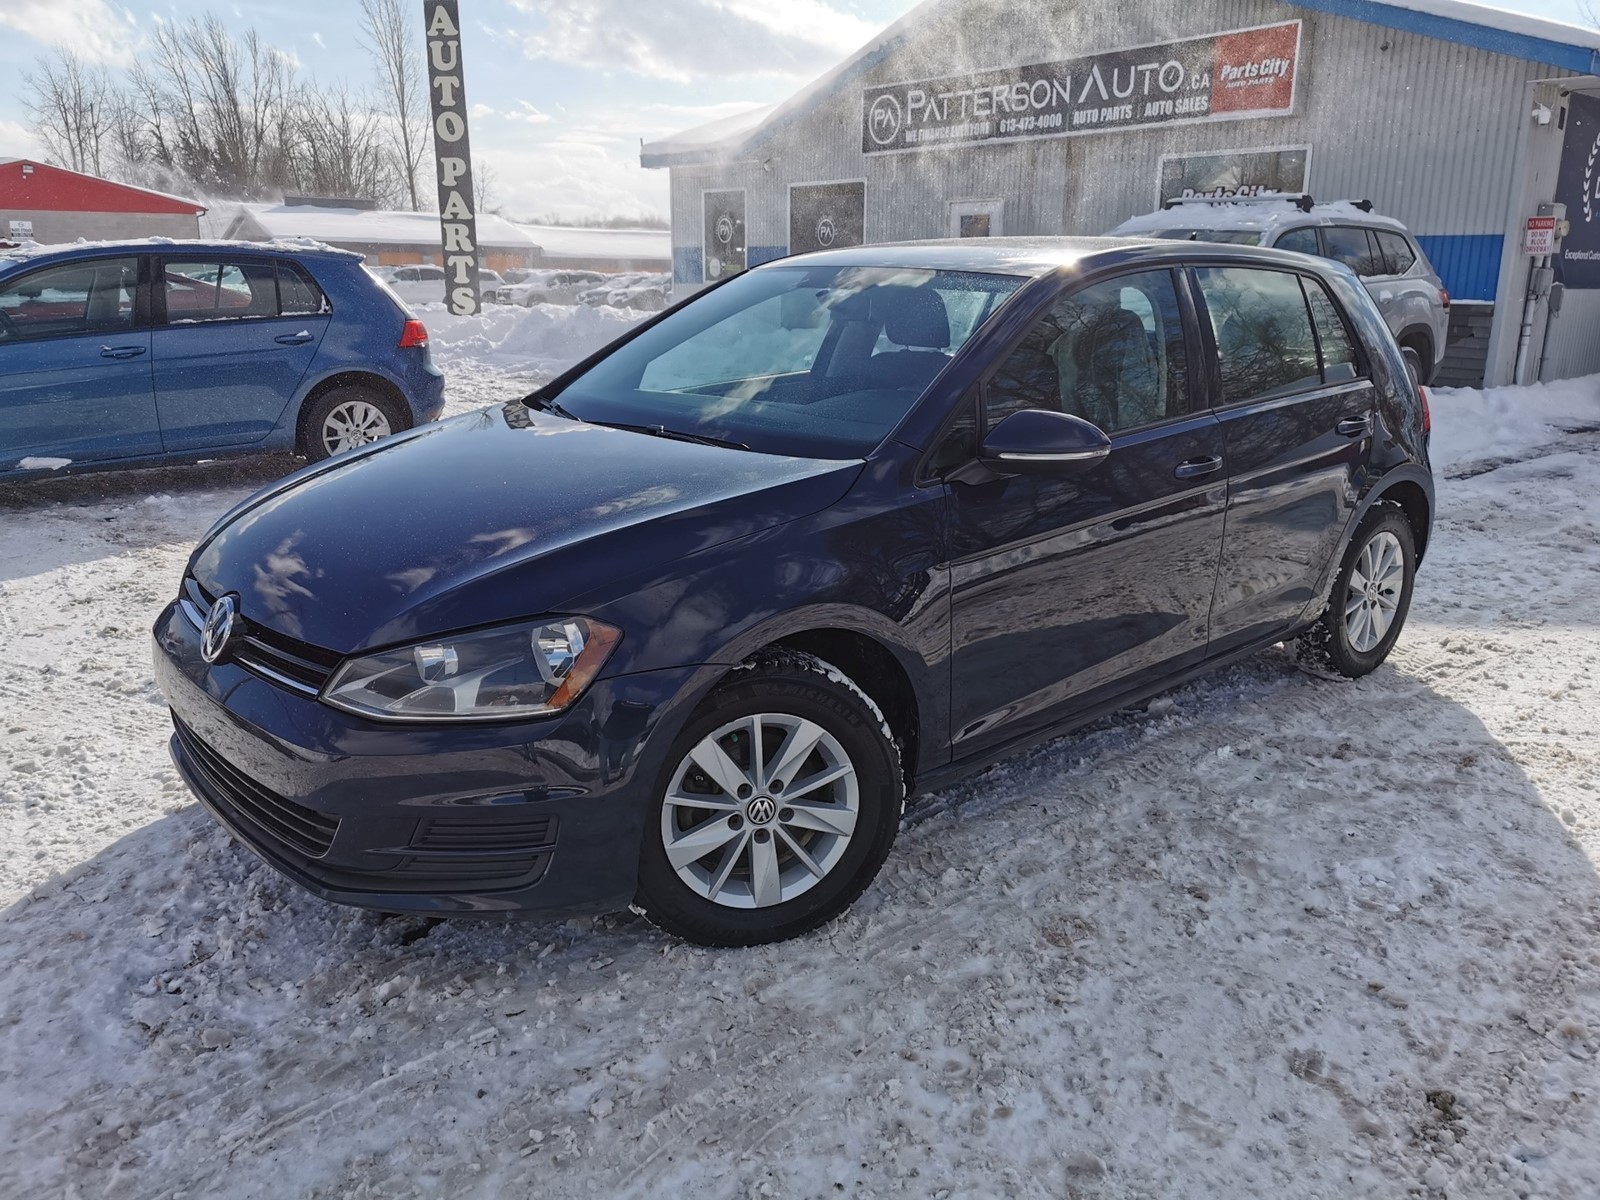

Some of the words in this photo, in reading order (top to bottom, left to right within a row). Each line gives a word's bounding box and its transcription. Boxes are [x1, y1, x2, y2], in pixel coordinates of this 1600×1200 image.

[427, 5, 465, 142] AUTO
[1000, 113, 1062, 133] 613-473-4000
[1072, 108, 1099, 125] AUTO
[1100, 105, 1133, 122] PARTS
[1144, 100, 1173, 117] AUTO
[1175, 96, 1208, 114] SALES
[440, 157, 476, 315] PARTS
[1528, 220, 1535, 228] NO
[1535, 218, 1554, 228] PARKING
